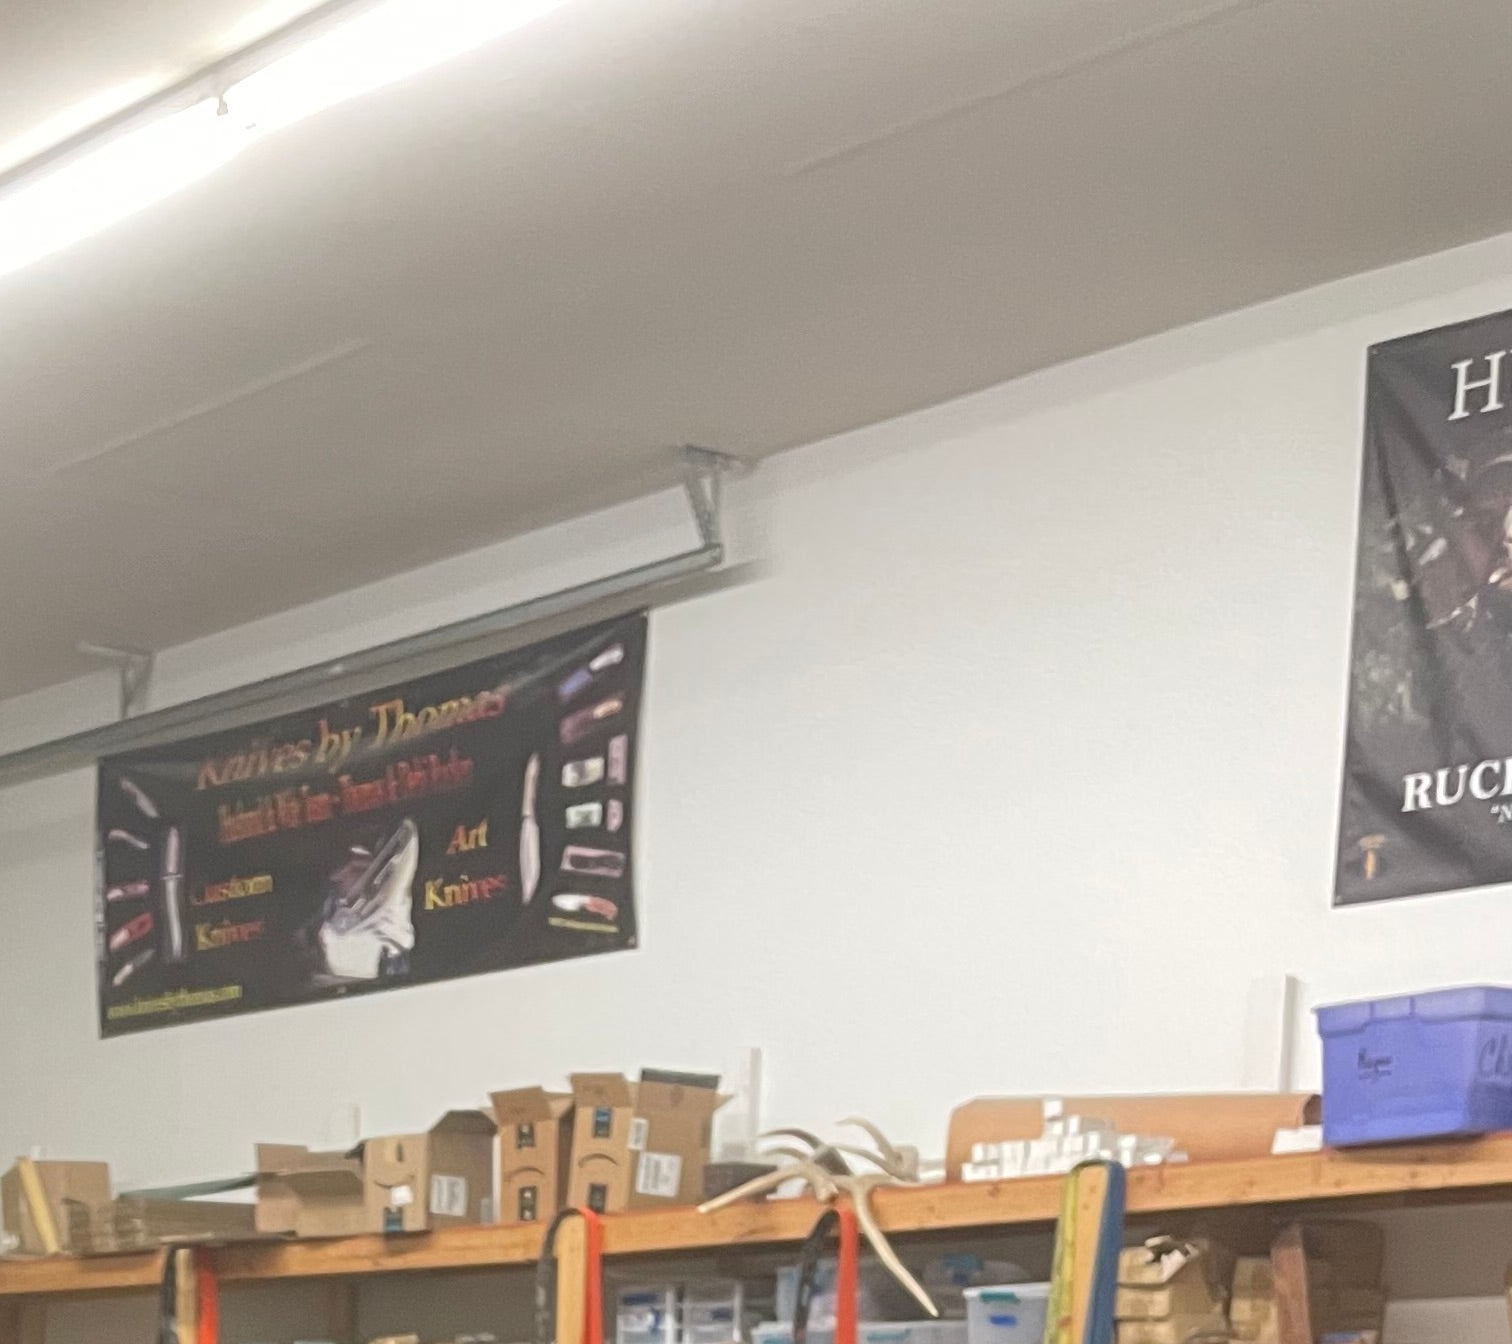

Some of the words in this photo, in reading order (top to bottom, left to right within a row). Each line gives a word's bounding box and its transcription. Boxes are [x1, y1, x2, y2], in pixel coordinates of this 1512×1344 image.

[1448, 350, 1512, 421] H
[316, 717, 362, 774] by
[445, 818, 489, 855] Art
[424, 875, 508, 911] Knives
